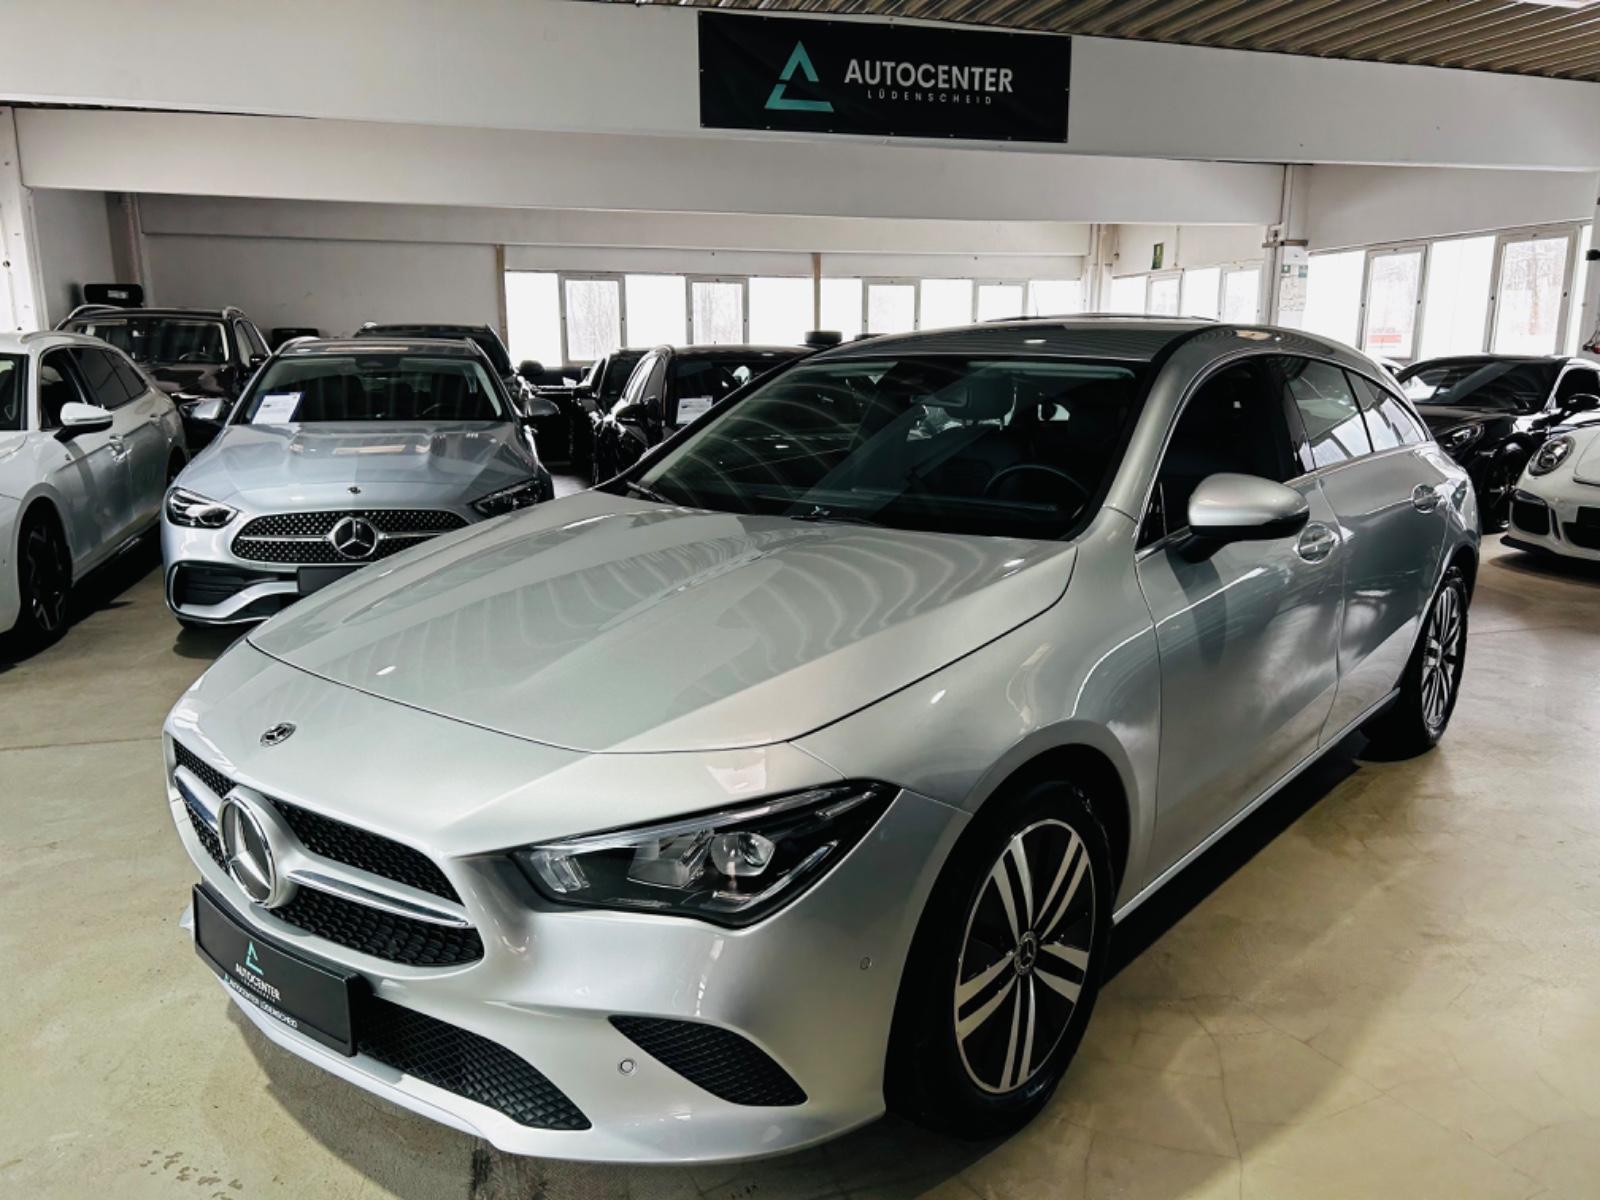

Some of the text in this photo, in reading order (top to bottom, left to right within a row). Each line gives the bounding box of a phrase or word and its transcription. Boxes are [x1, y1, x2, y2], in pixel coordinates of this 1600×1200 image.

[844, 58, 1014, 93] AUTOCENTER
[867, 88, 992, 105] LÜDENSCHEID
[235, 962, 281, 1001] AUTOCENTER
